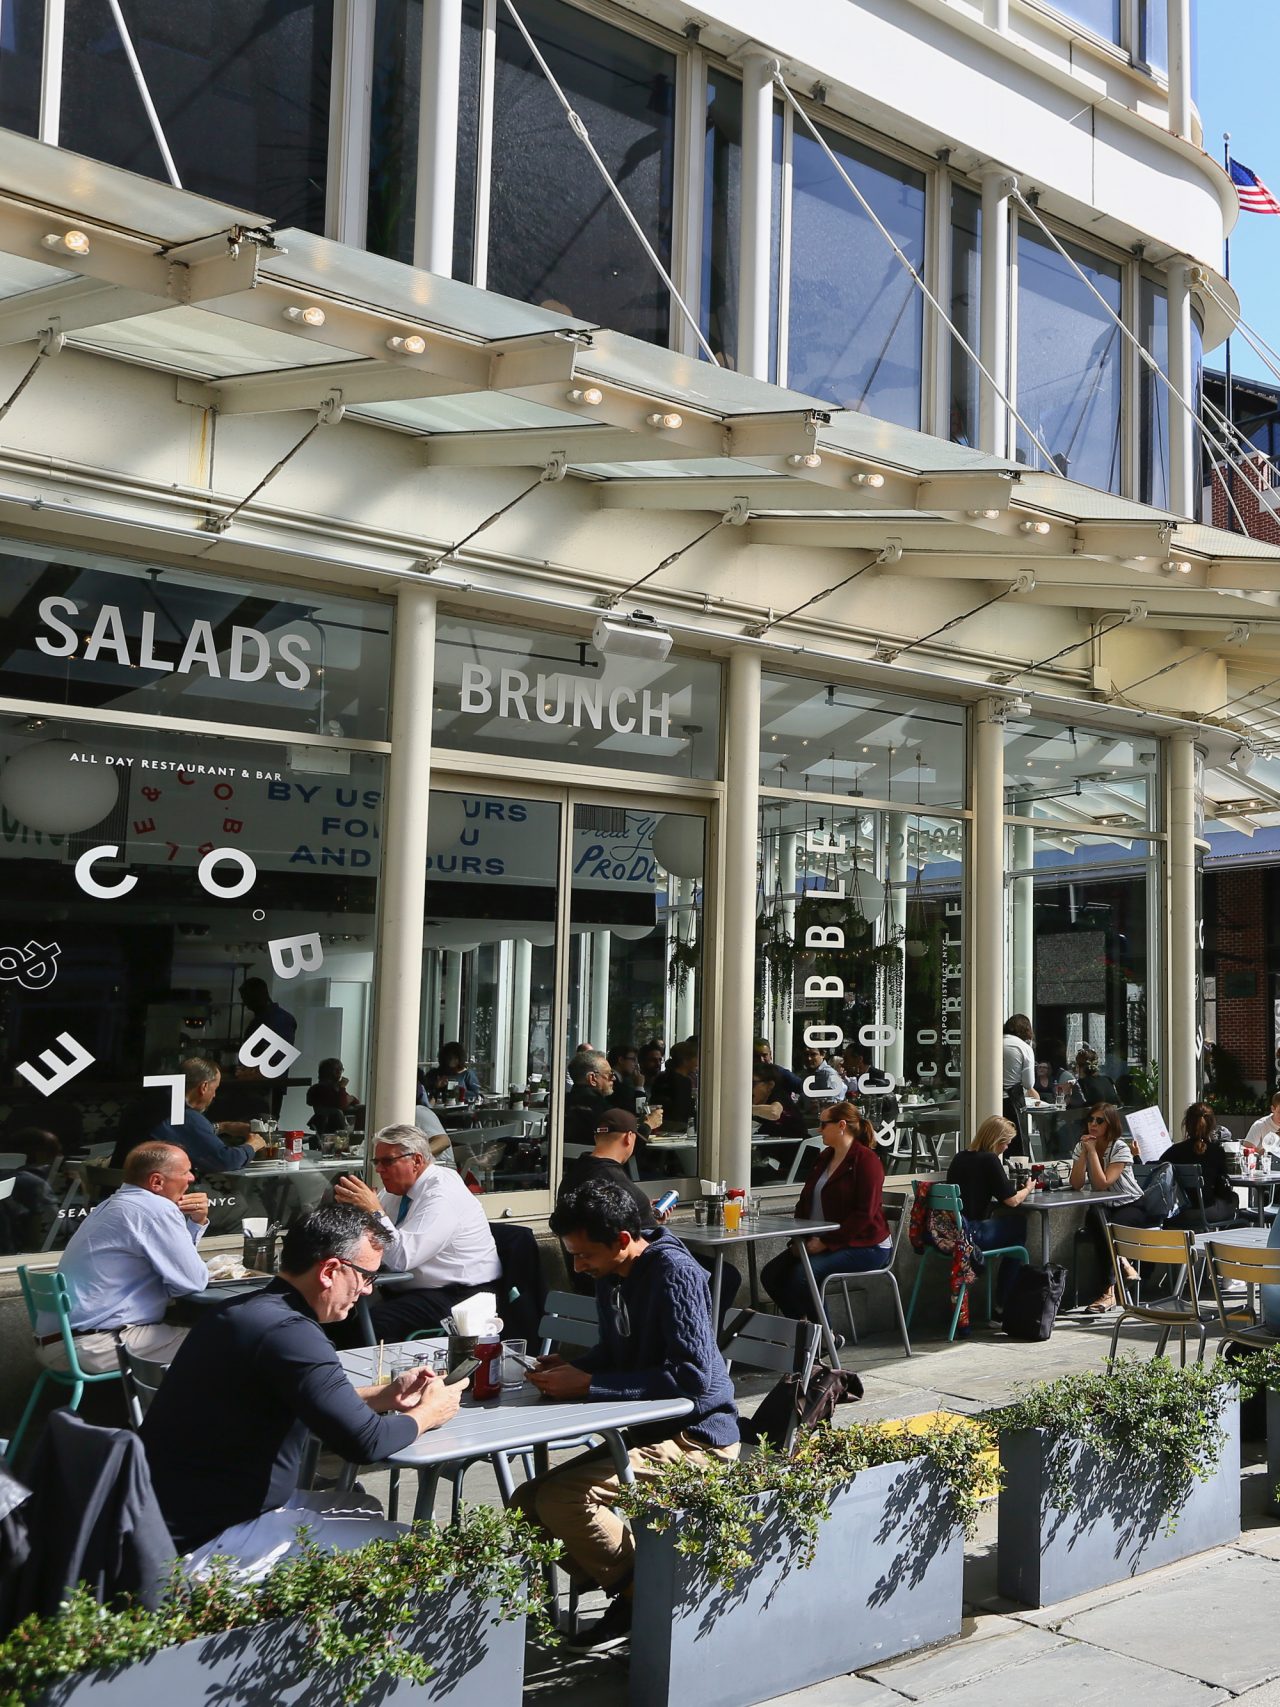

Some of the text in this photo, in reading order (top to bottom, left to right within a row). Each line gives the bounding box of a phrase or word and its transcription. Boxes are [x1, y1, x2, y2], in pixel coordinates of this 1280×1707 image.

[34, 595, 313, 690] SALADS
[460, 662, 672, 738] BRUNCH
[69, 753, 283, 782] ALL DAY RESTAURANT & BAR
[268, 782, 321, 803] BY
[288, 844, 371, 867] AND
[803, 834, 847, 1098] COBBLE
[858, 1024, 897, 1095] CO
